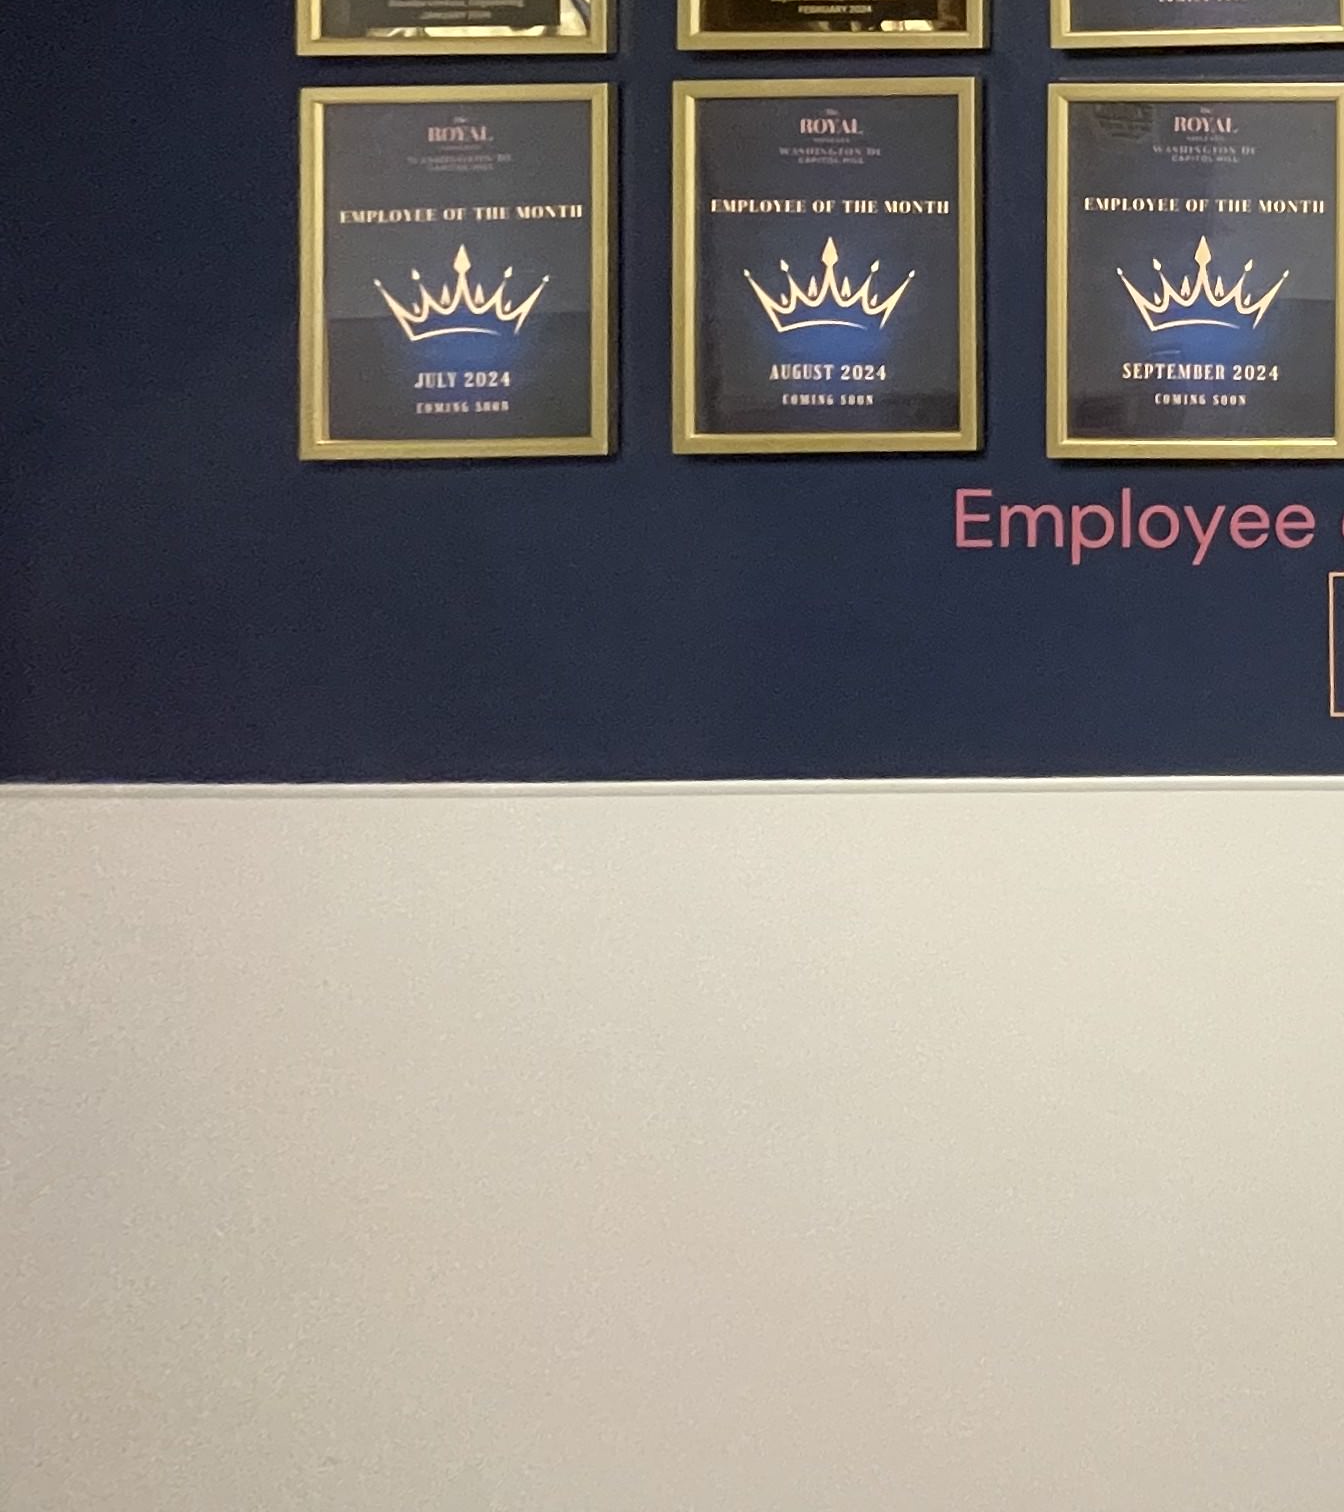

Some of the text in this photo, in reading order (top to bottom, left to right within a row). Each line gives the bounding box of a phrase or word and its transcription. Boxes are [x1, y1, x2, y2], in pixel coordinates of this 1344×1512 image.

[800, 119, 863, 135] ROYAL
[1174, 117, 1239, 133] ROYAL
[427, 126, 493, 142] ROYAL
[711, 200, 948, 213] EMPLOYEE OF THE MONTH
[1085, 198, 1324, 213] EMPLOYEE OF THE MONTH
[340, 205, 582, 223] EMPLOYEE OF THE MONTH
[415, 371, 510, 388] JULY 2024
[770, 364, 886, 380] AUGUST 2024
[1123, 363, 1278, 380] SEPTEMBER 2024
[782, 394, 834, 405] COMING
[1155, 394, 1245, 405] COMING SOON
[956, 488, 1315, 565] Employee
